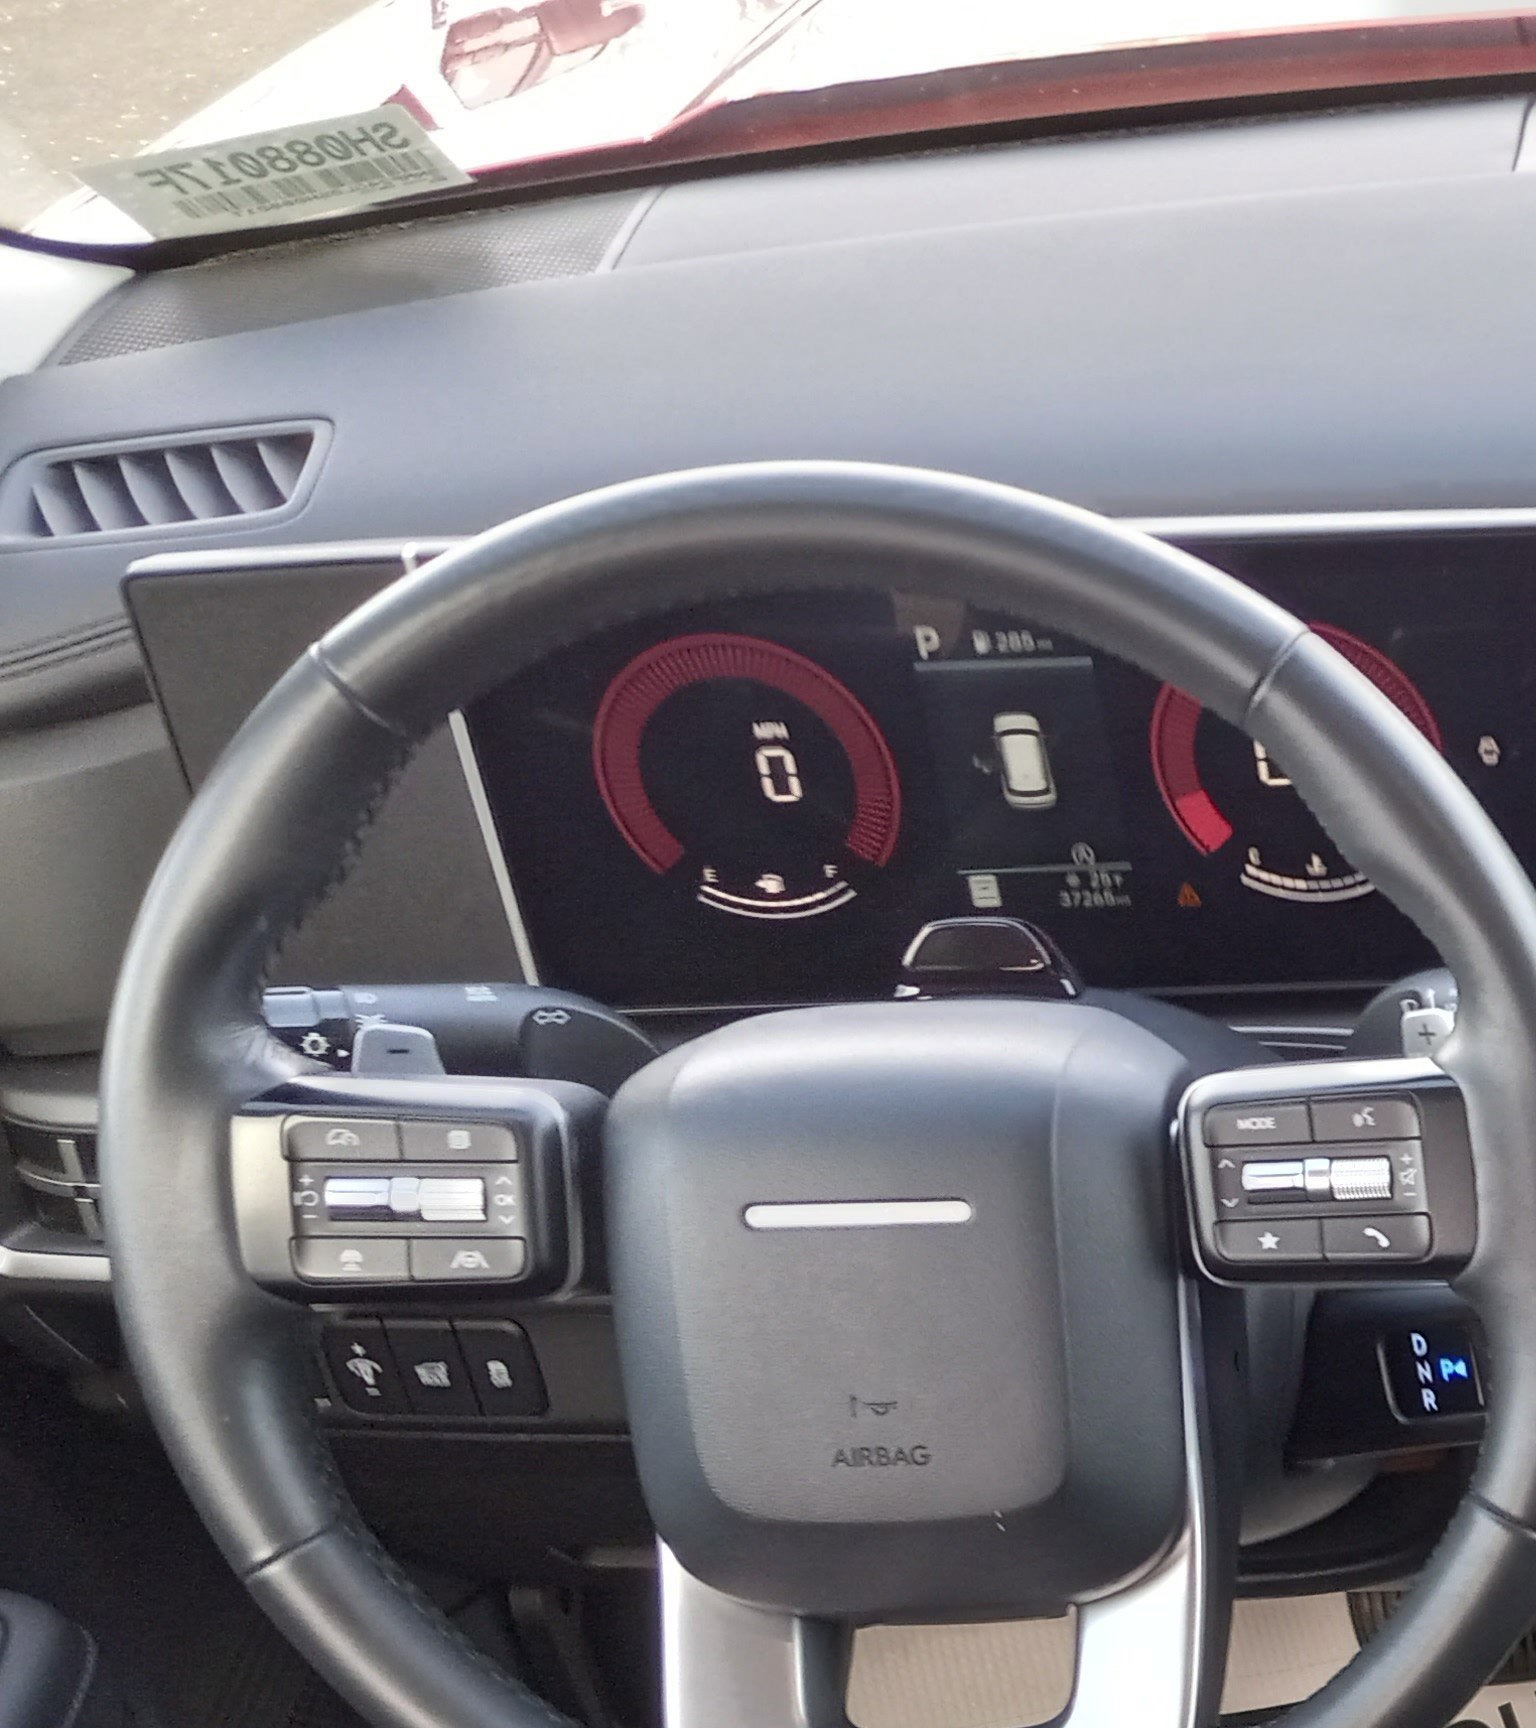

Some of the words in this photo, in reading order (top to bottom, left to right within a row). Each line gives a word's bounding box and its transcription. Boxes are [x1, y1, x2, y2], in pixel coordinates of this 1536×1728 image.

[913, 624, 941, 661] P
[755, 745, 803, 803] 0
[702, 866, 719, 883] E
[823, 864, 839, 878] F
[1236, 1116, 1277, 1131] MODE
[1410, 1332, 1428, 1357] D
[1415, 1360, 1434, 1385] N
[1421, 1388, 1439, 1412] R
[830, 1445, 932, 1468] AIRBAG
